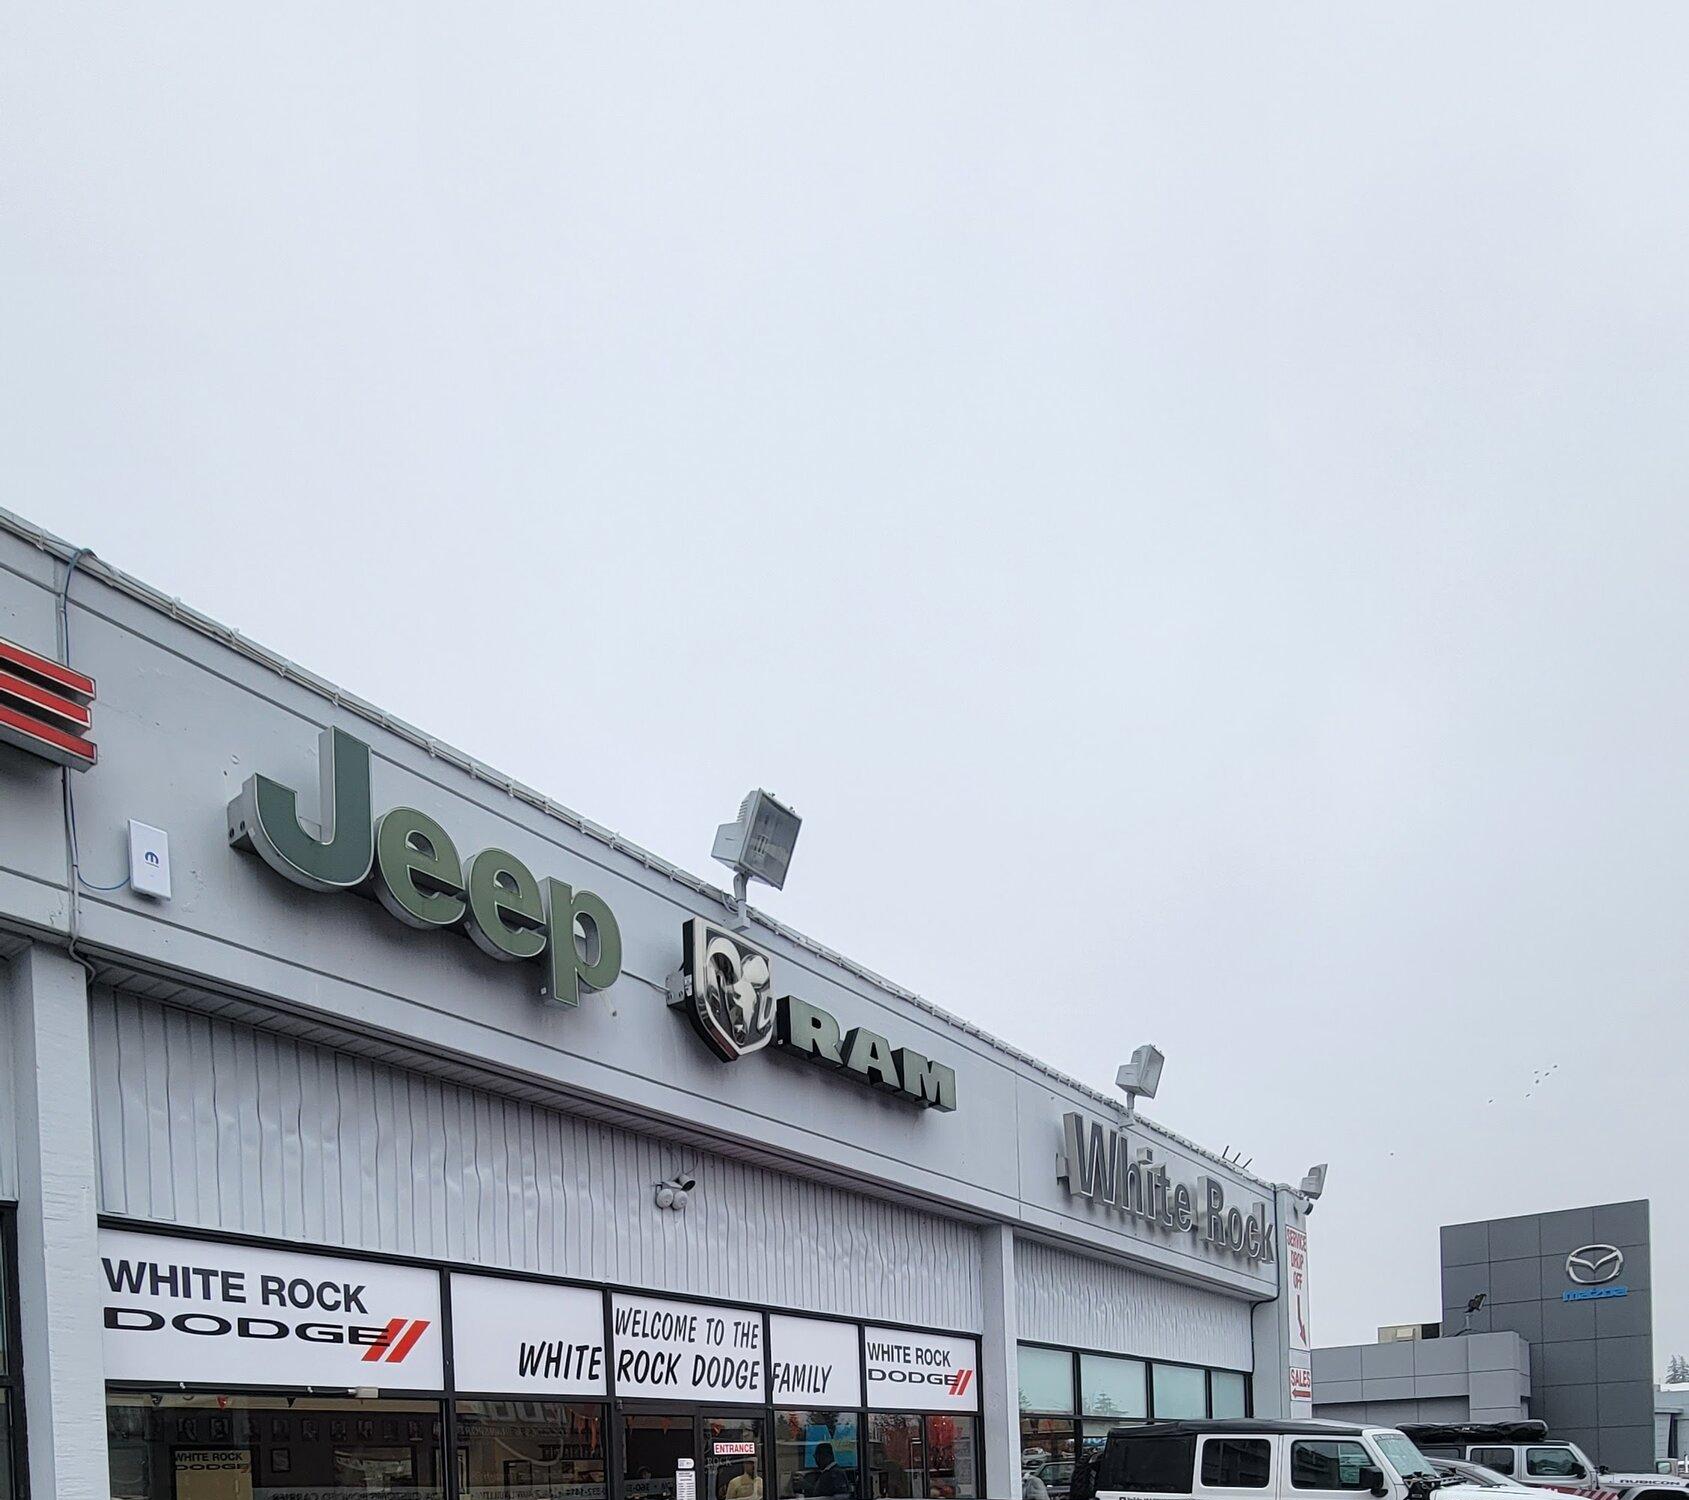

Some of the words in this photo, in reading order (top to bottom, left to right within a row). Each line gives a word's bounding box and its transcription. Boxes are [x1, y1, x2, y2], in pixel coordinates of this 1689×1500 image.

[248, 725, 622, 1007] Jeep
[786, 995, 957, 1112] RAM
[1066, 1112, 1193, 1232] White
[1199, 1176, 1275, 1264] Rock
[1286, 1229, 1307, 1251] SERVICE
[1291, 1250, 1304, 1270] DROP
[101, 1258, 247, 1303] WHITE
[260, 1275, 369, 1314] ROCK
[1293, 1273, 1303, 1290] OFF
[1563, 1286, 1628, 1302] mazda
[104, 1307, 391, 1347] DODGE
[615, 1308, 697, 1343] WELCOME
[706, 1318, 725, 1346] TO
[733, 1320, 759, 1349] THE
[867, 1342, 911, 1363] WHITE
[915, 1348, 951, 1367] ROCK
[518, 1341, 602, 1381] WHITE
[617, 1349, 682, 1385] ROCK
[692, 1354, 760, 1390] DODGE
[772, 1362, 833, 1394] FAMILY
[868, 1369, 958, 1385] DODGE
[1291, 1369, 1310, 1388] SALES
[212, 1452, 242, 1461] ROCK
[715, 1444, 753, 1453] ENTRANCE
